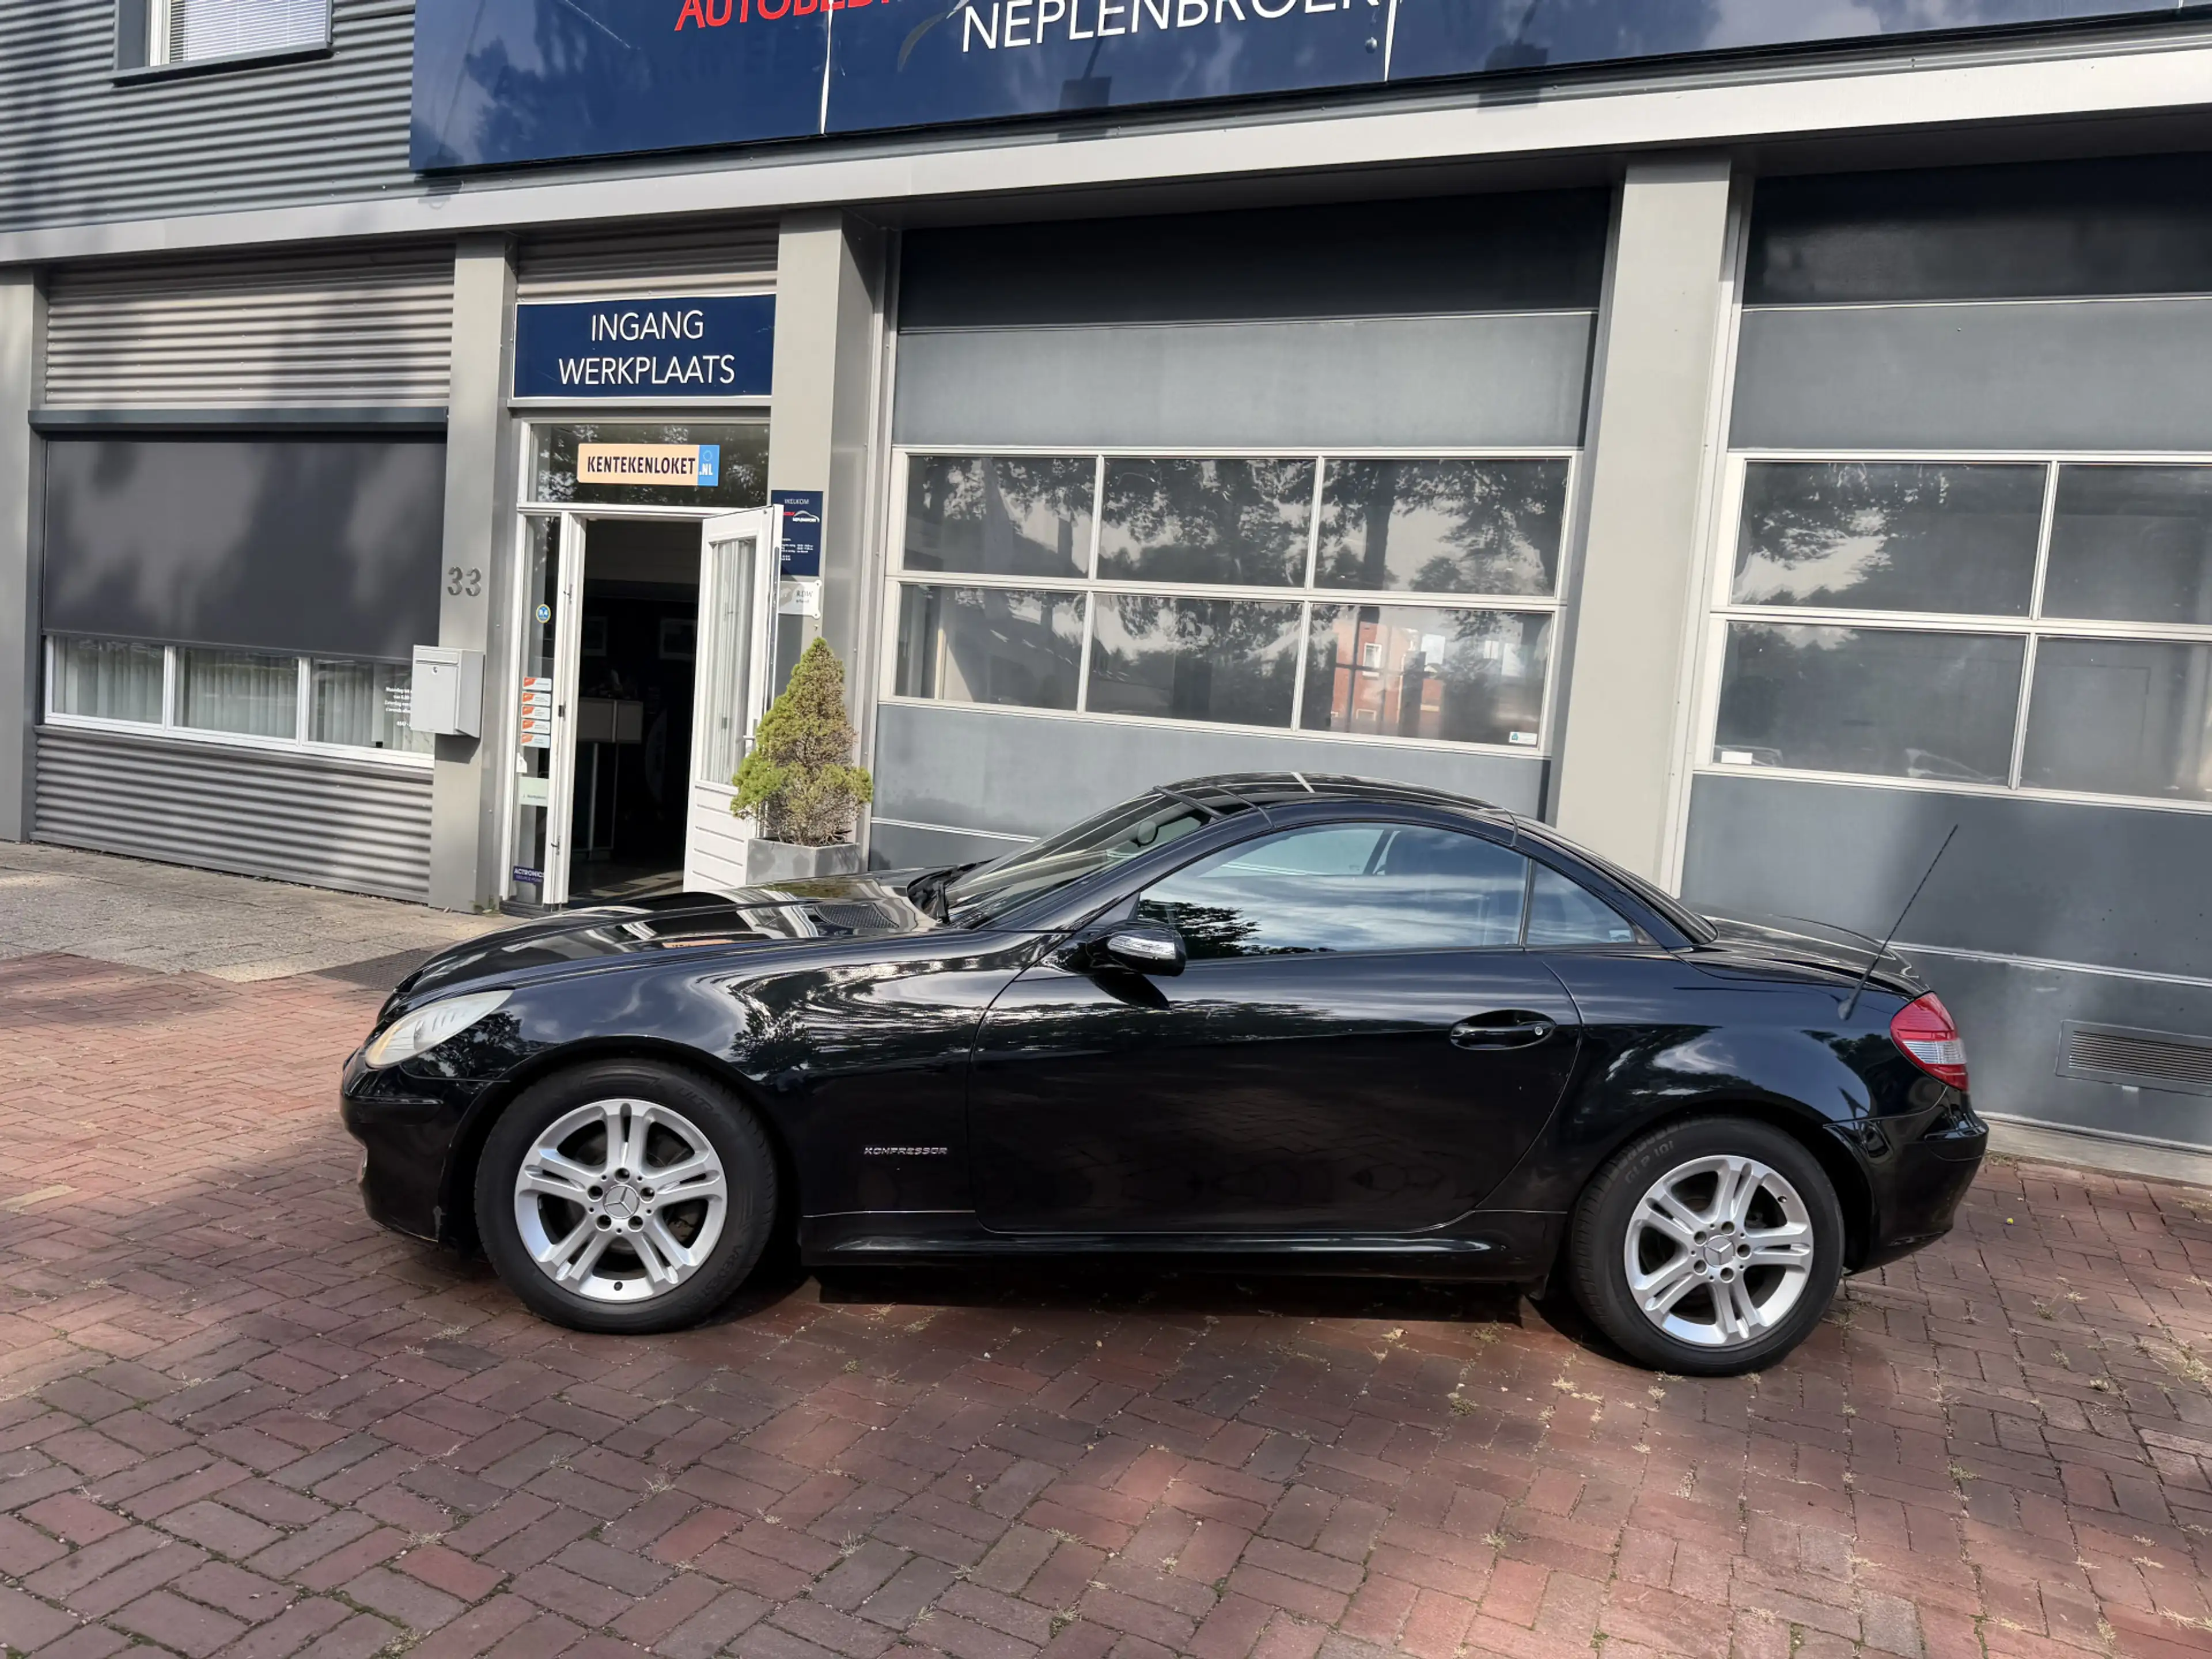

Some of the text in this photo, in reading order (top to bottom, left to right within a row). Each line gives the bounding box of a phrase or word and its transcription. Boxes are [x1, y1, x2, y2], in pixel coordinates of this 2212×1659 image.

[962, 0, 1380, 53] NEPLENB
[591, 310, 704, 342] INGANG
[559, 354, 736, 385] WERKPLAATS
[446, 566, 482, 596] 33
